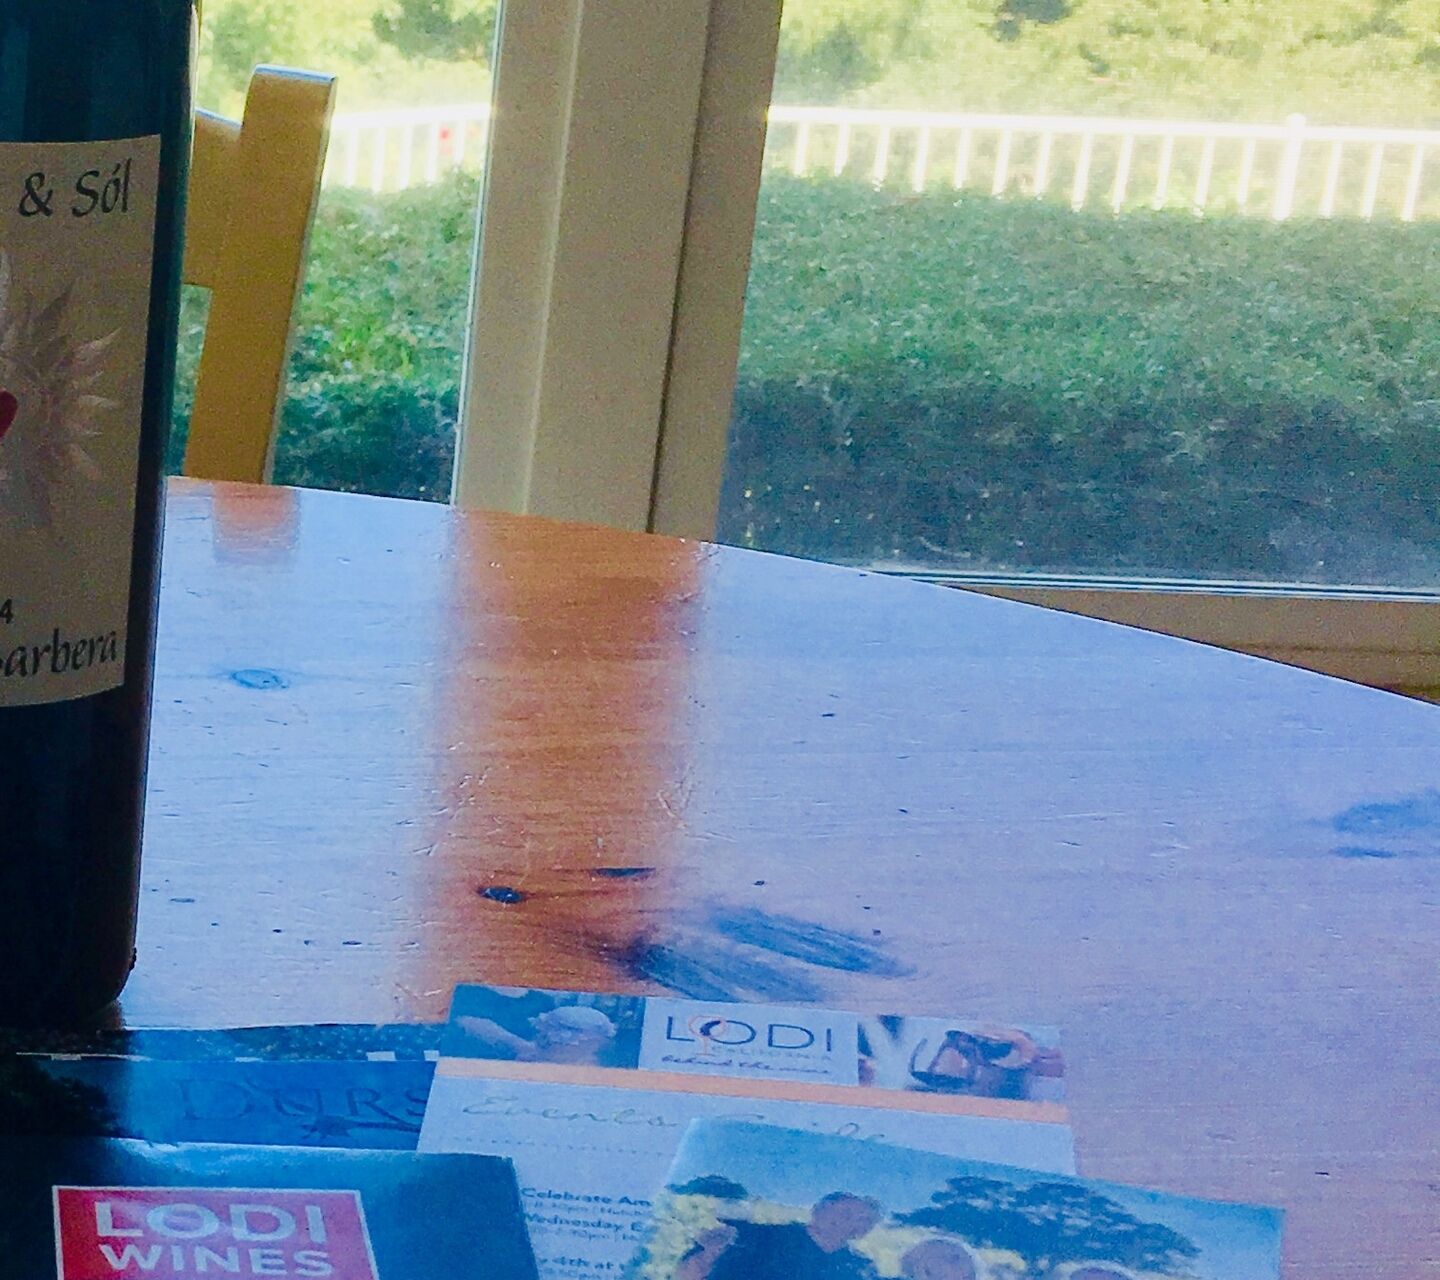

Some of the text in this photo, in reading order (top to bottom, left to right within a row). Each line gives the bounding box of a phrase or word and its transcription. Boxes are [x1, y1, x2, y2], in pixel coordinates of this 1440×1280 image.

[19, 172, 54, 218] &
[666, 1015, 832, 1052] LODI
[521, 1187, 613, 1205] Celebrate
[94, 1200, 327, 1246] LODI
[98, 1243, 333, 1277] WINES
